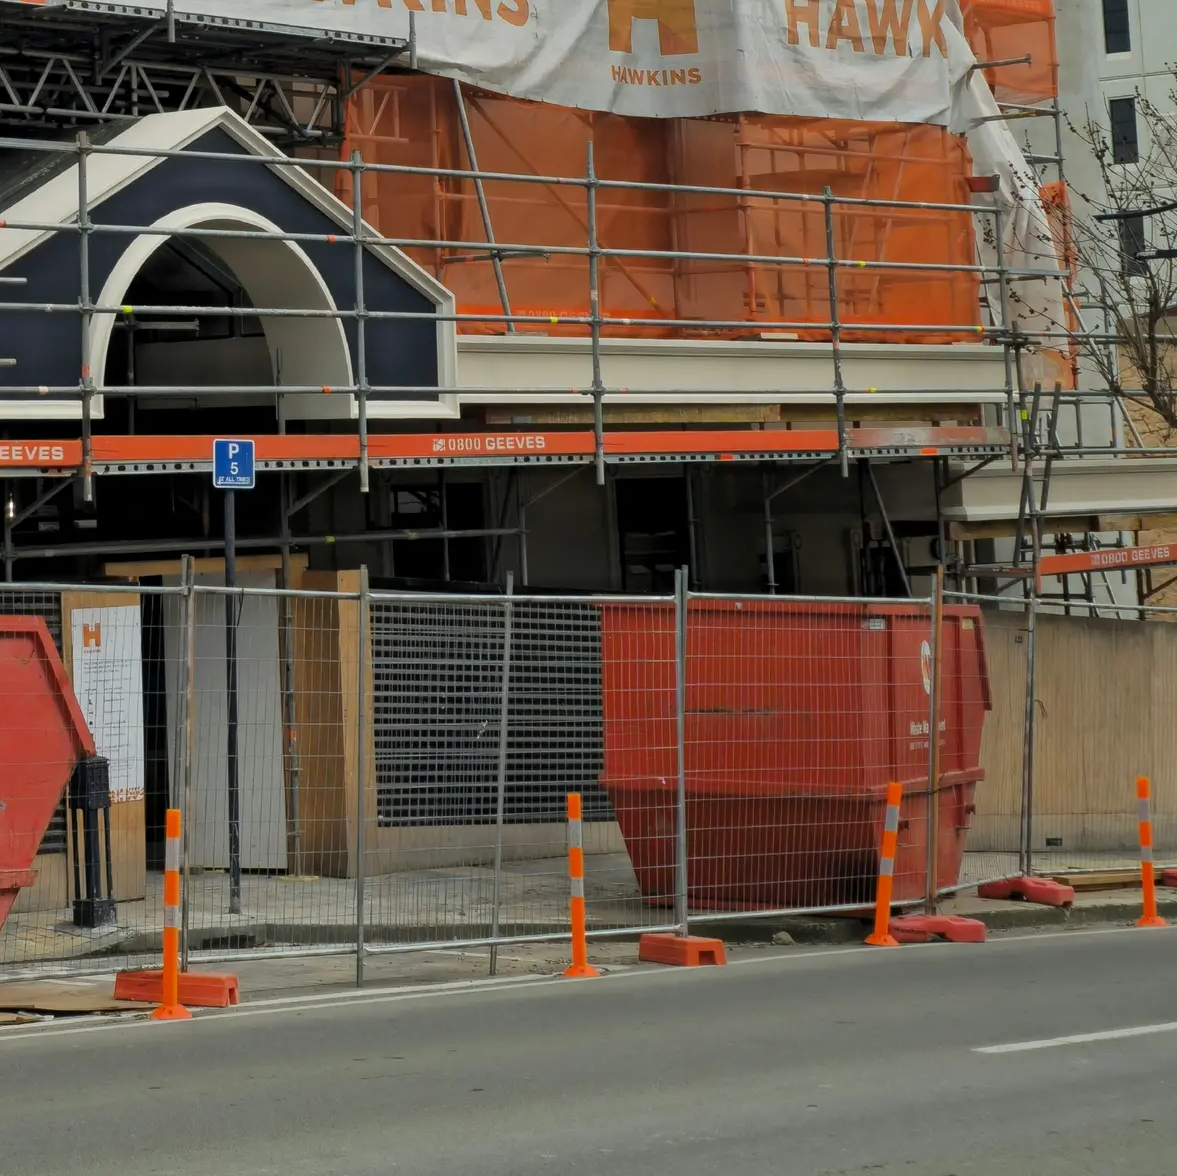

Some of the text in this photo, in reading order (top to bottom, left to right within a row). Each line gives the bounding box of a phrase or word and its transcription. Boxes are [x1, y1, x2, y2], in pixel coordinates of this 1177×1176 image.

[610, 64, 702, 87] HAWKINS
[228, 442, 240, 459] P
[448, 436, 546, 451] 0800 GEEVES
[230, 461, 239, 475] 5
[1131, 546, 1170, 562] GEEVES
[82, 622, 102, 648] H
